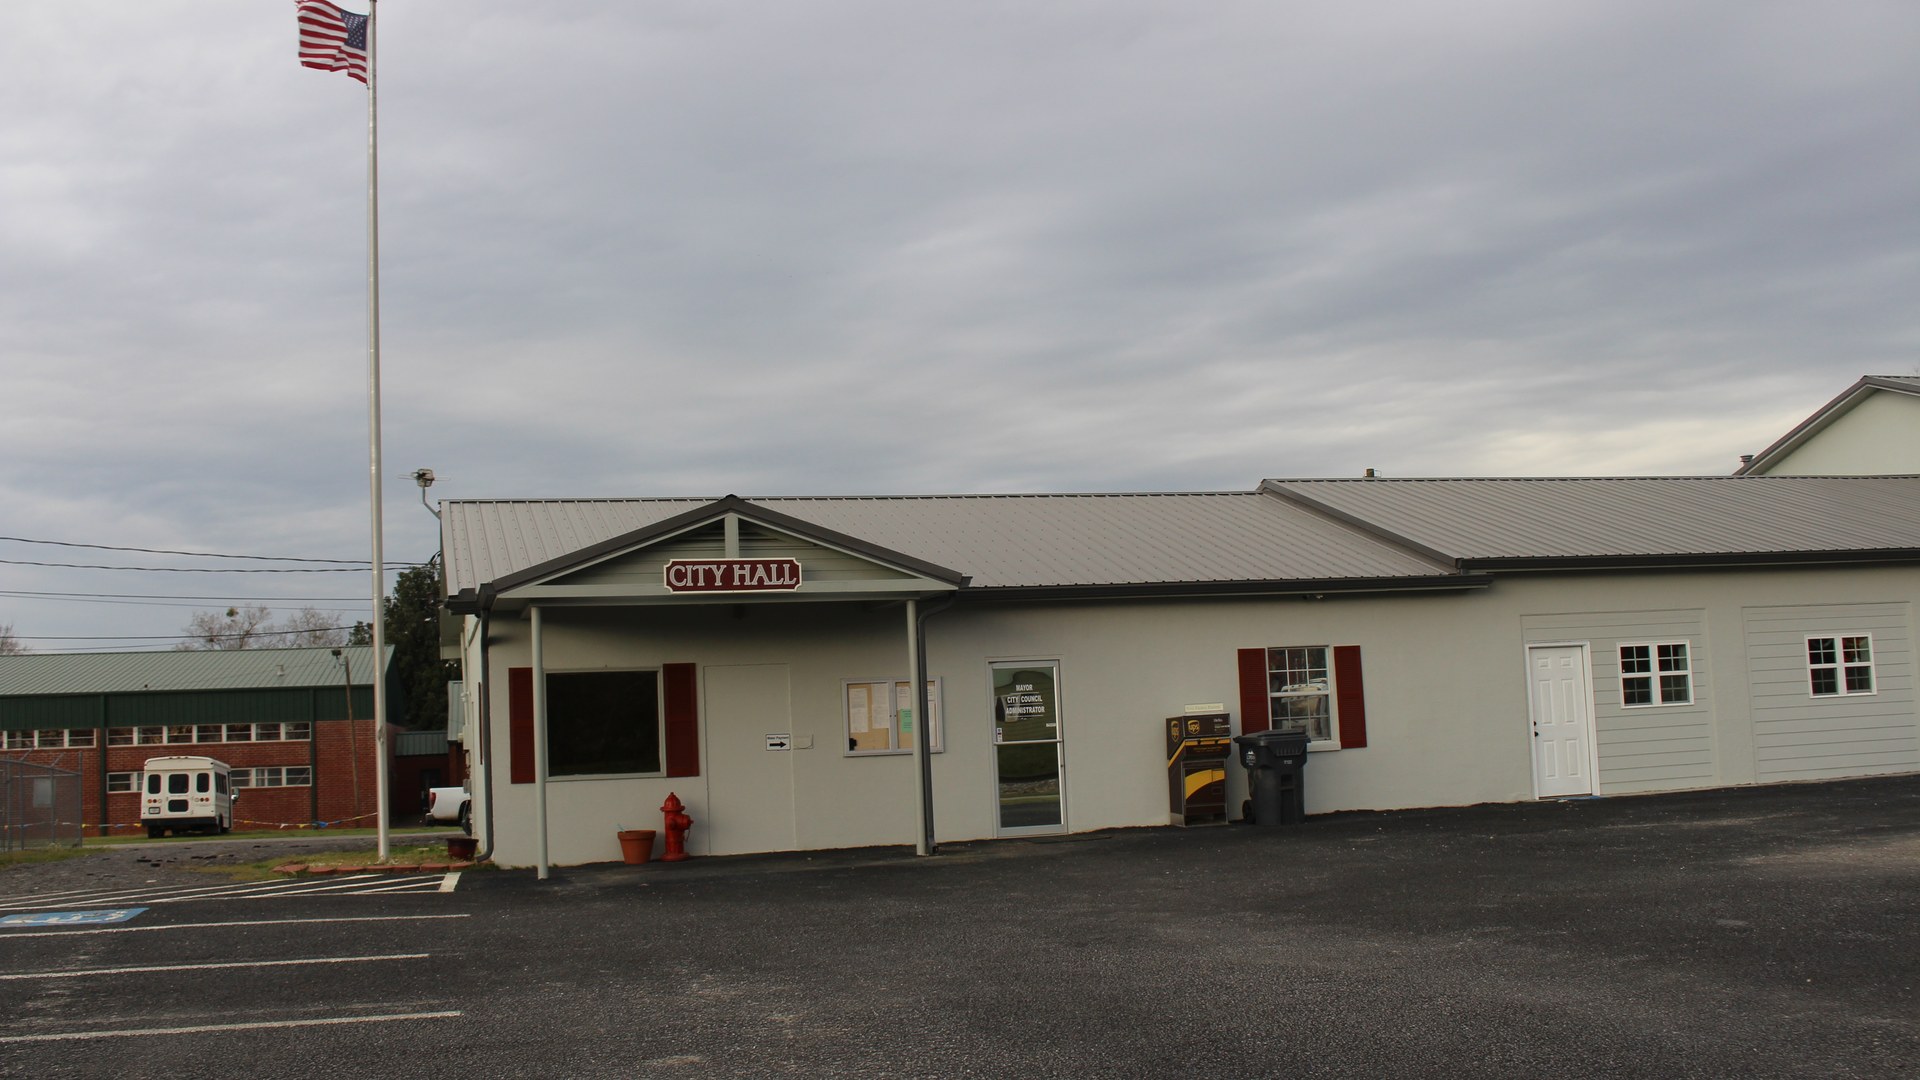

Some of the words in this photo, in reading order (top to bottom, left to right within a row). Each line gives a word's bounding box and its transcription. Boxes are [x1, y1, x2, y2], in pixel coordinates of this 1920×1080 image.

[669, 564, 727, 587] CITY
[733, 563, 797, 586] HALL
[1006, 706, 1045, 714] ADMINISTRATOR
